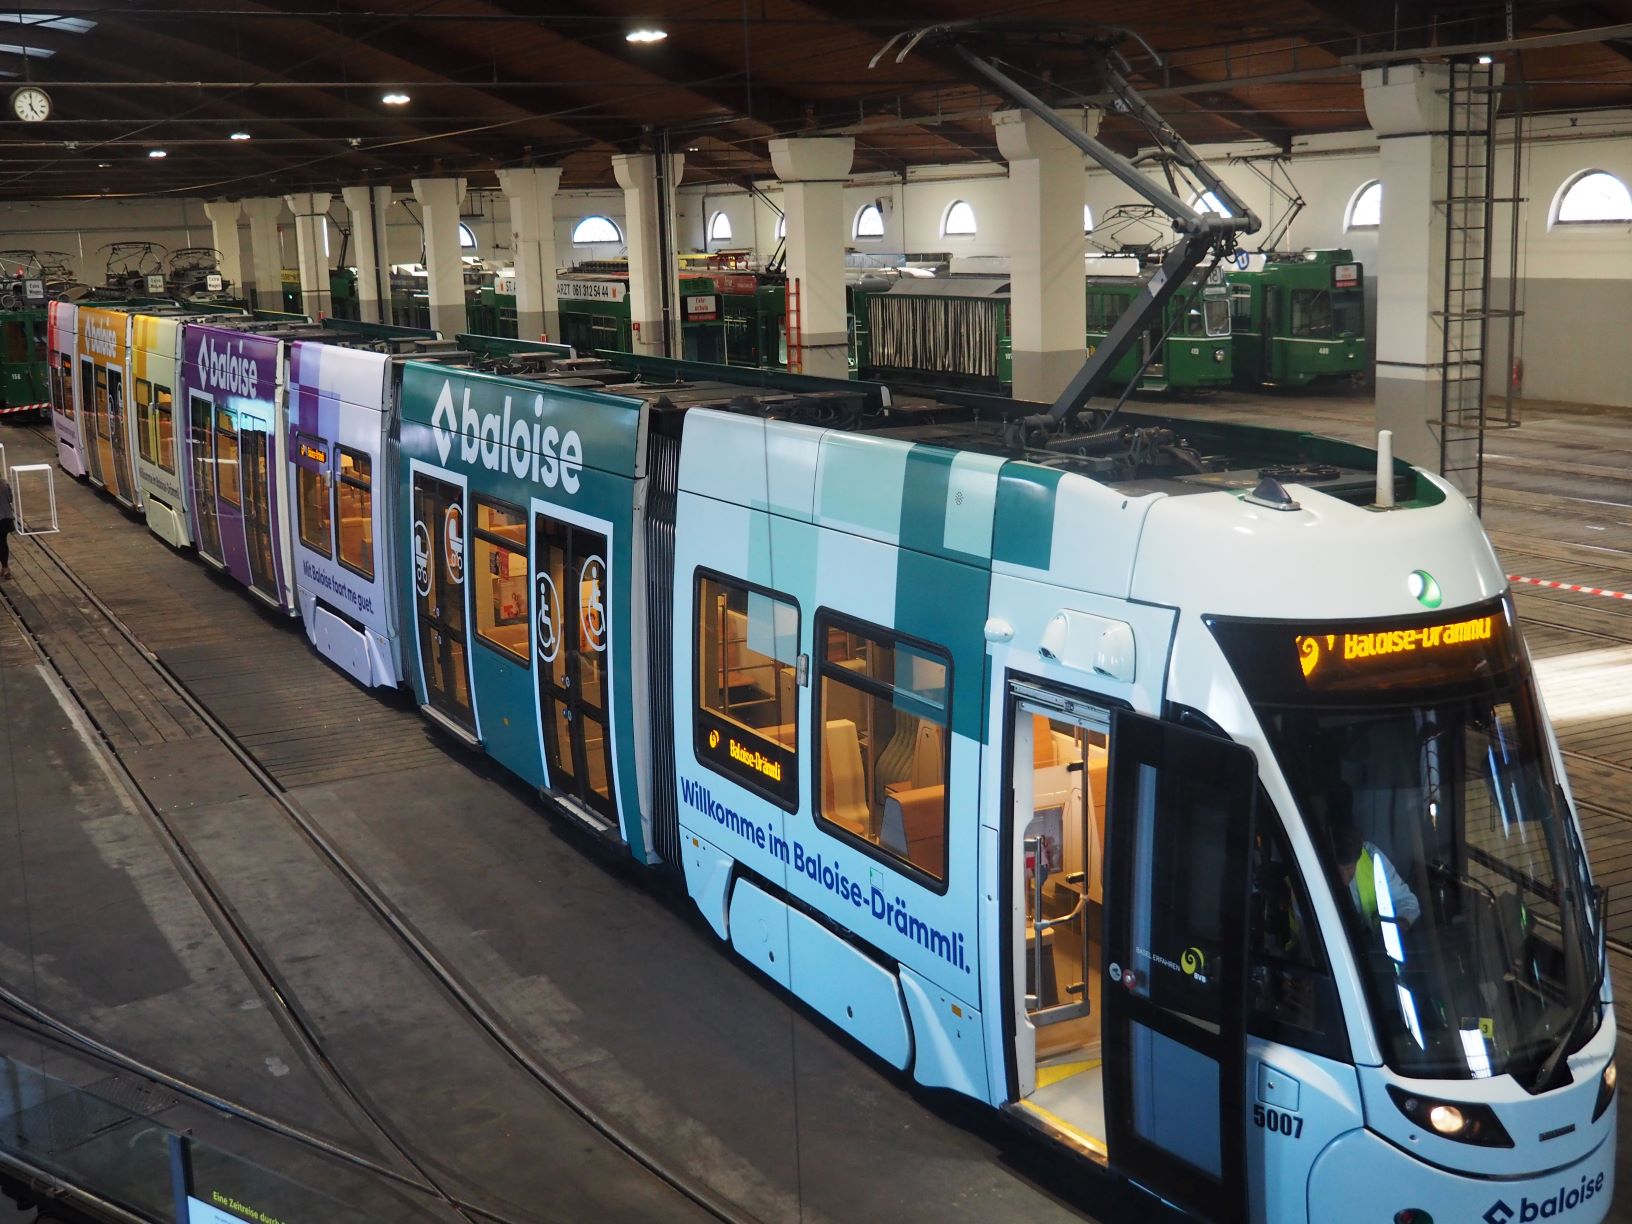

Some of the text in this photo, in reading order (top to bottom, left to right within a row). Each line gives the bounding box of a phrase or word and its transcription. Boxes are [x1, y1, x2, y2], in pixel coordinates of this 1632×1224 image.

[573, 282, 581, 295] 061
[582, 282, 593, 296] 312
[593, 284, 600, 296] 54
[602, 285, 609, 297] 44
[91, 317, 116, 359] baloise
[210, 338, 257, 398] baloise
[461, 387, 583, 494] baloise
[312, 564, 332, 590] Baloise
[729, 739, 781, 781] Baloise-Drämmli
[681, 776, 971, 974] Willkomme im Baloise-Drämmli.
[1152, 954, 1181, 972] ERFAHREN
[1194, 972, 1206, 983] BVB
[1482, 1024, 1488, 1034] 3
[1254, 1104, 1303, 1139] 5007
[213, 1191, 228, 1206] Eine
[229, 1198, 259, 1219] Zeitreise
[1519, 1171, 1604, 1224] baloise
